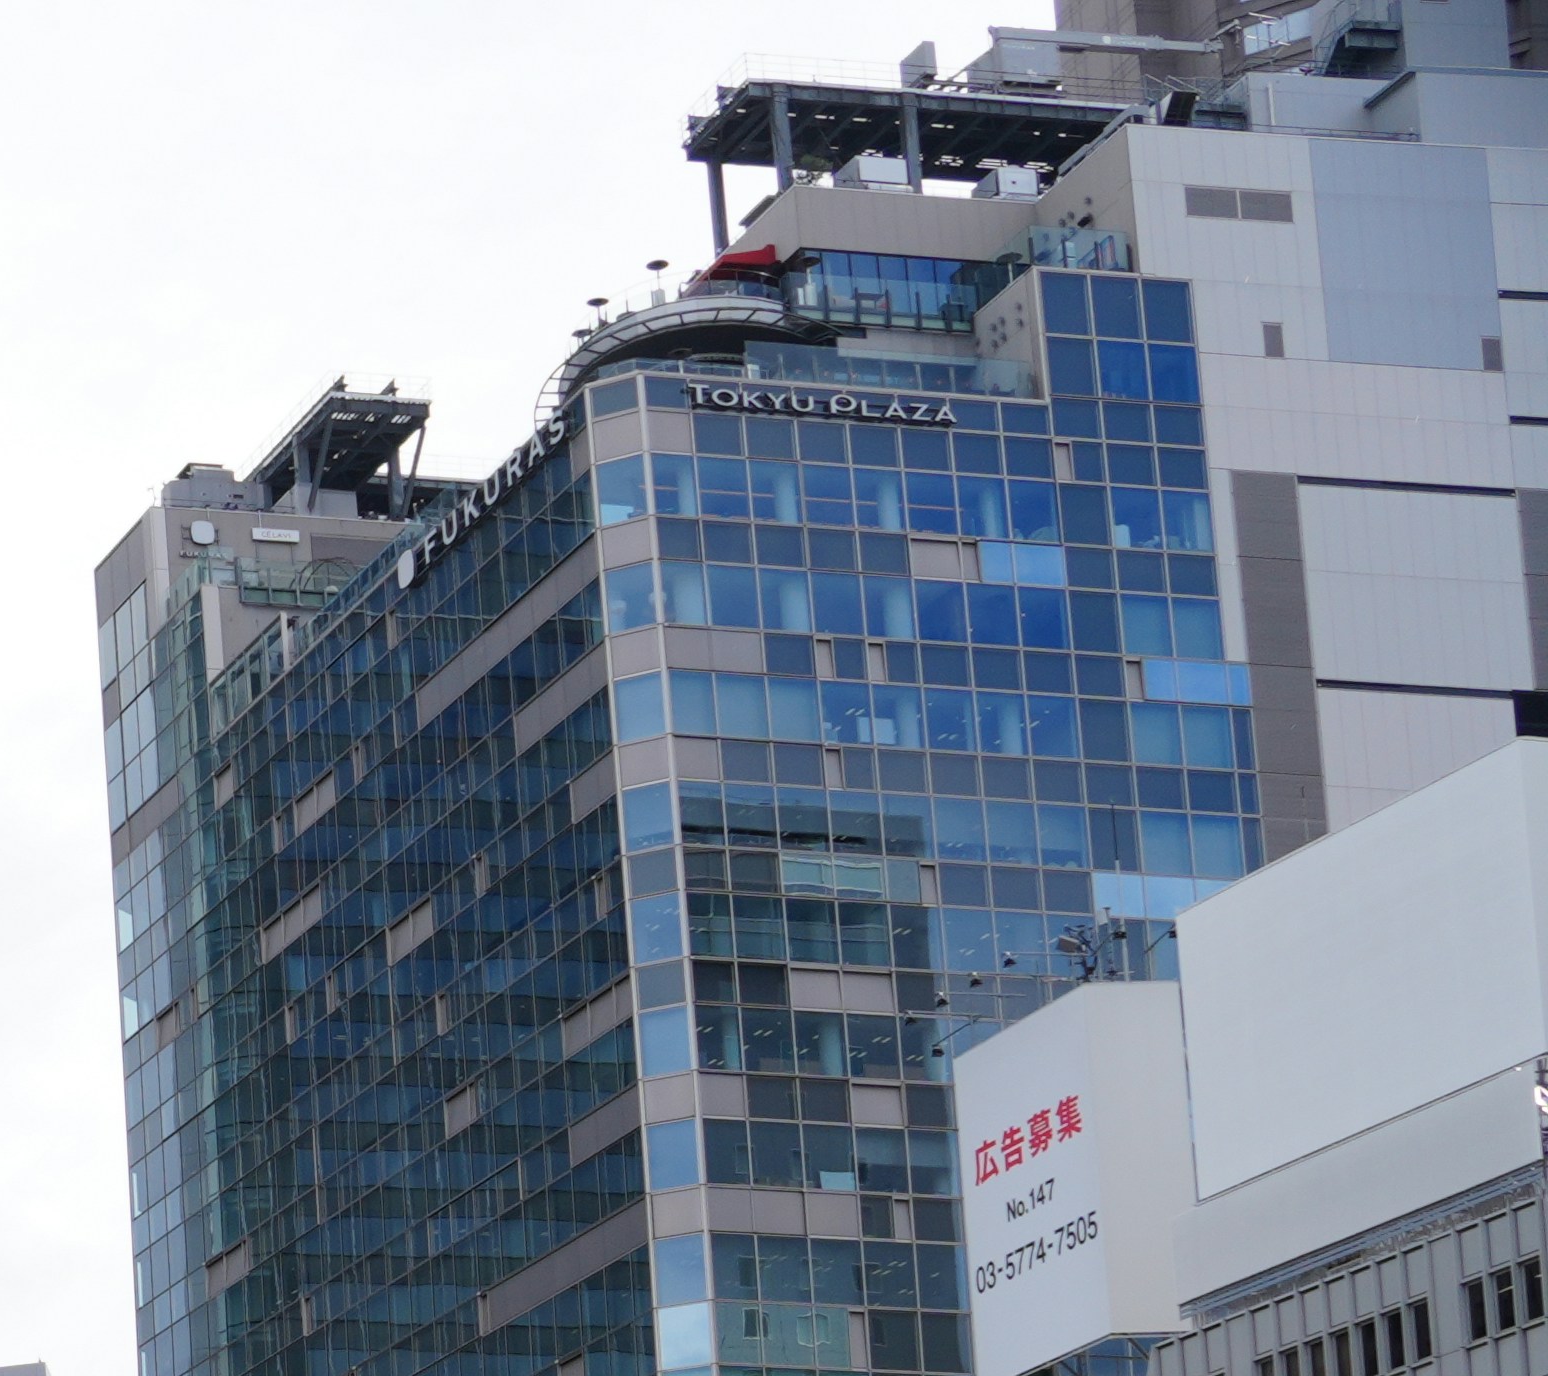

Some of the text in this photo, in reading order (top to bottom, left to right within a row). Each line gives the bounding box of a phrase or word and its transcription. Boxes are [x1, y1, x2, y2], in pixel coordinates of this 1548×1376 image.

[688, 383, 957, 423] TOKYU PLAZA
[421, 406, 568, 564] FUKURAS
[974, 1094, 1083, 1187] 広告募集
[1006, 1177, 1055, 1223] No.147
[975, 1210, 1099, 1294] 03-5774-7505
